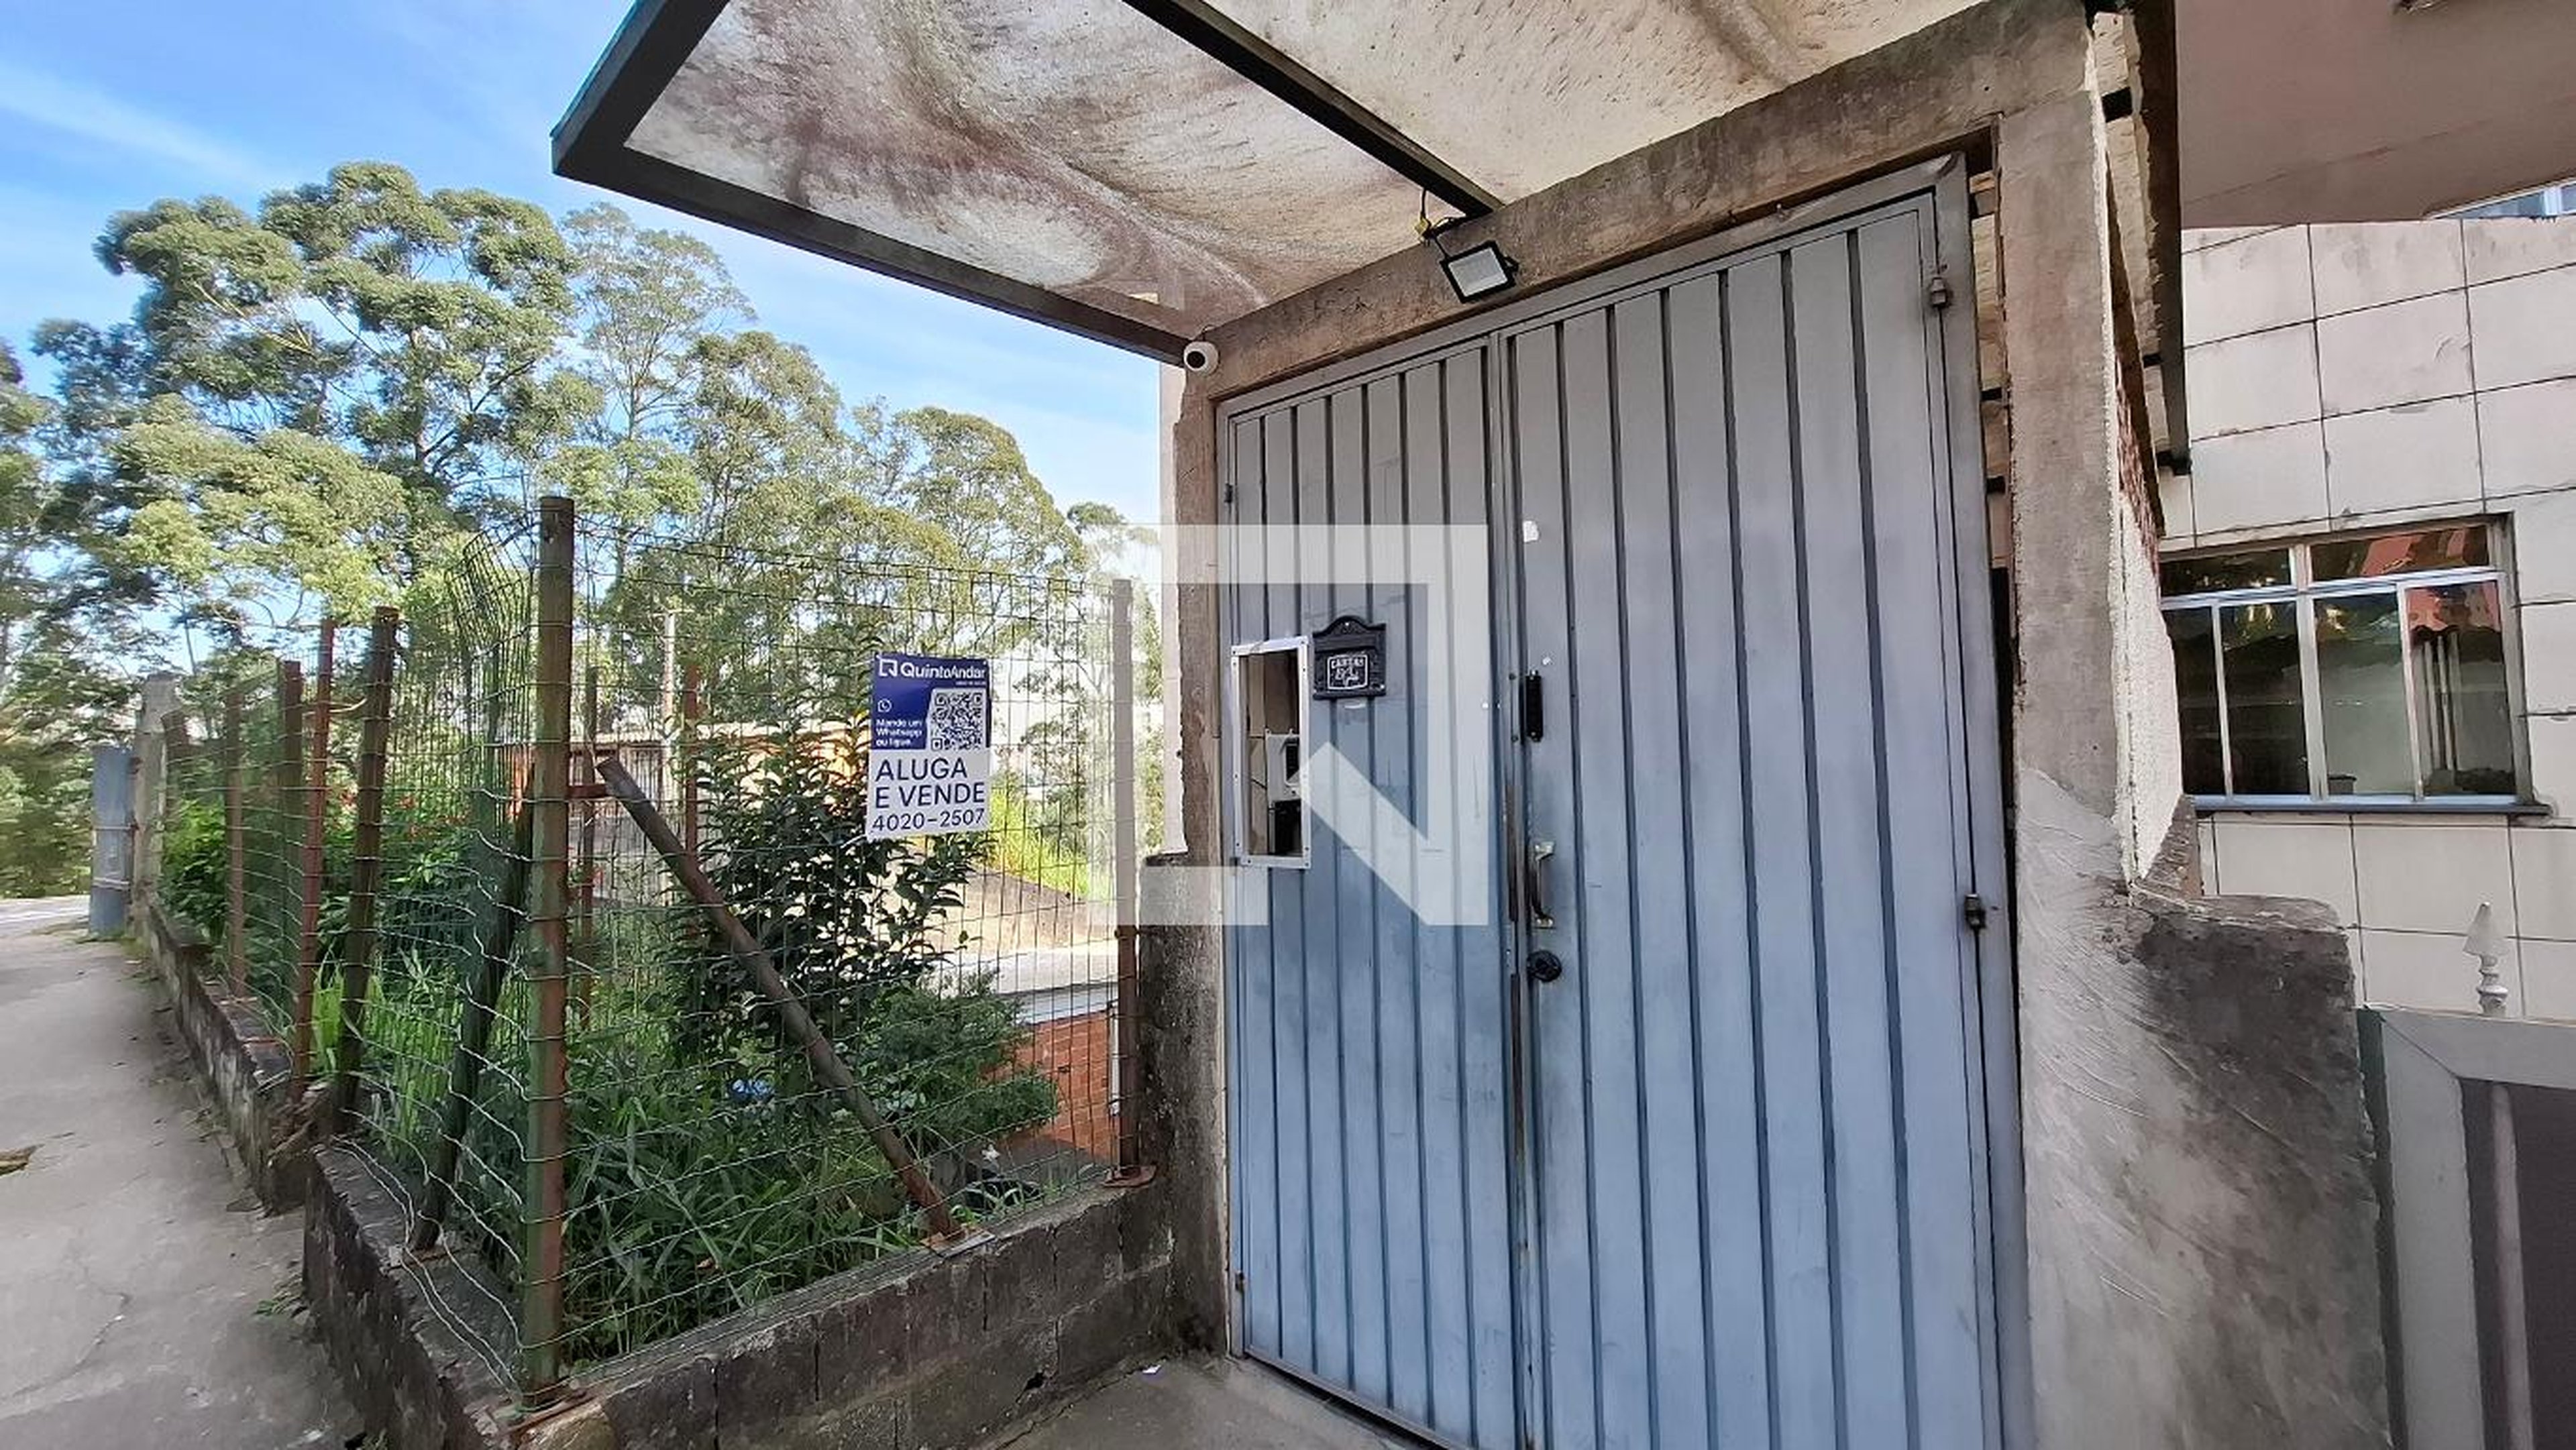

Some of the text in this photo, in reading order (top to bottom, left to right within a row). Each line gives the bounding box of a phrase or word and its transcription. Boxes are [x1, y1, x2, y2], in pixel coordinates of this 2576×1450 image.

[900, 661, 985, 679] QuintoAndar
[875, 757, 968, 782] ALUGA
[875, 782, 985, 808] E VENDE
[872, 808, 985, 832] 4020-2507
